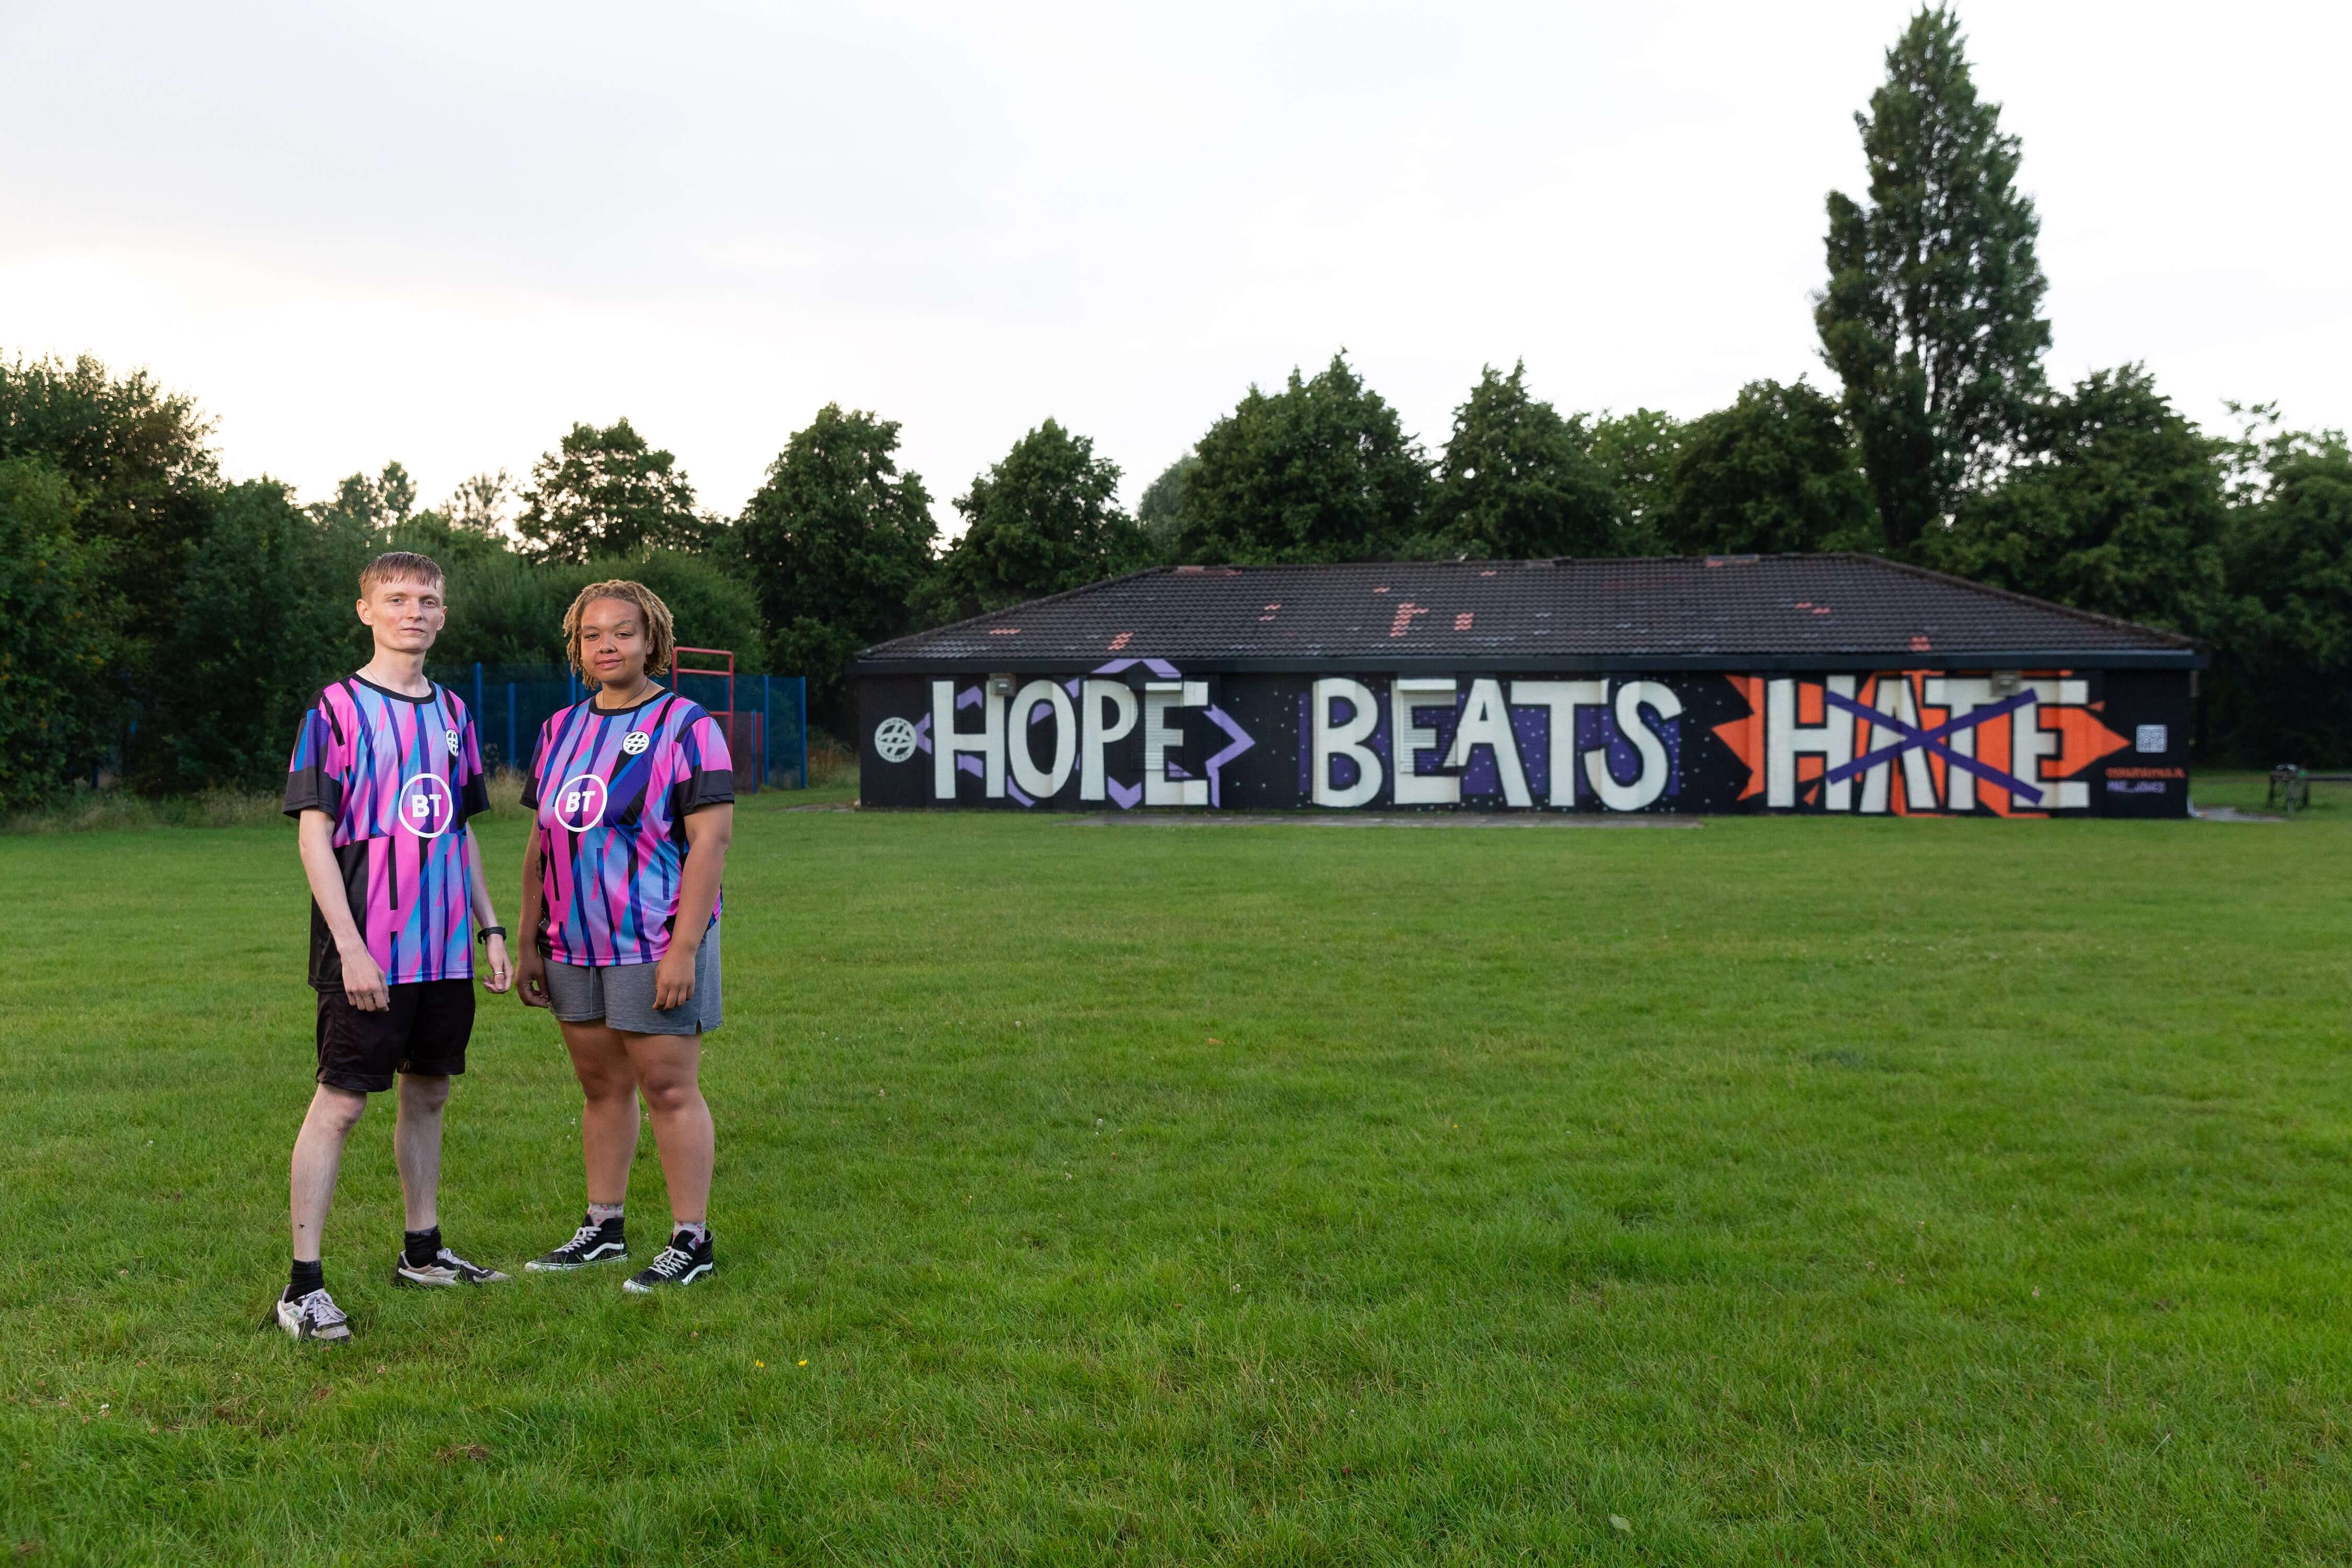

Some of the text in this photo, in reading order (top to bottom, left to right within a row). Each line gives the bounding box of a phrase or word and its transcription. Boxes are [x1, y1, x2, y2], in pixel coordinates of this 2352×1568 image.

[932, 674, 2089, 813] HOPE BEATS HATE
[412, 794, 442, 817] BT
[565, 790, 596, 813] BT
